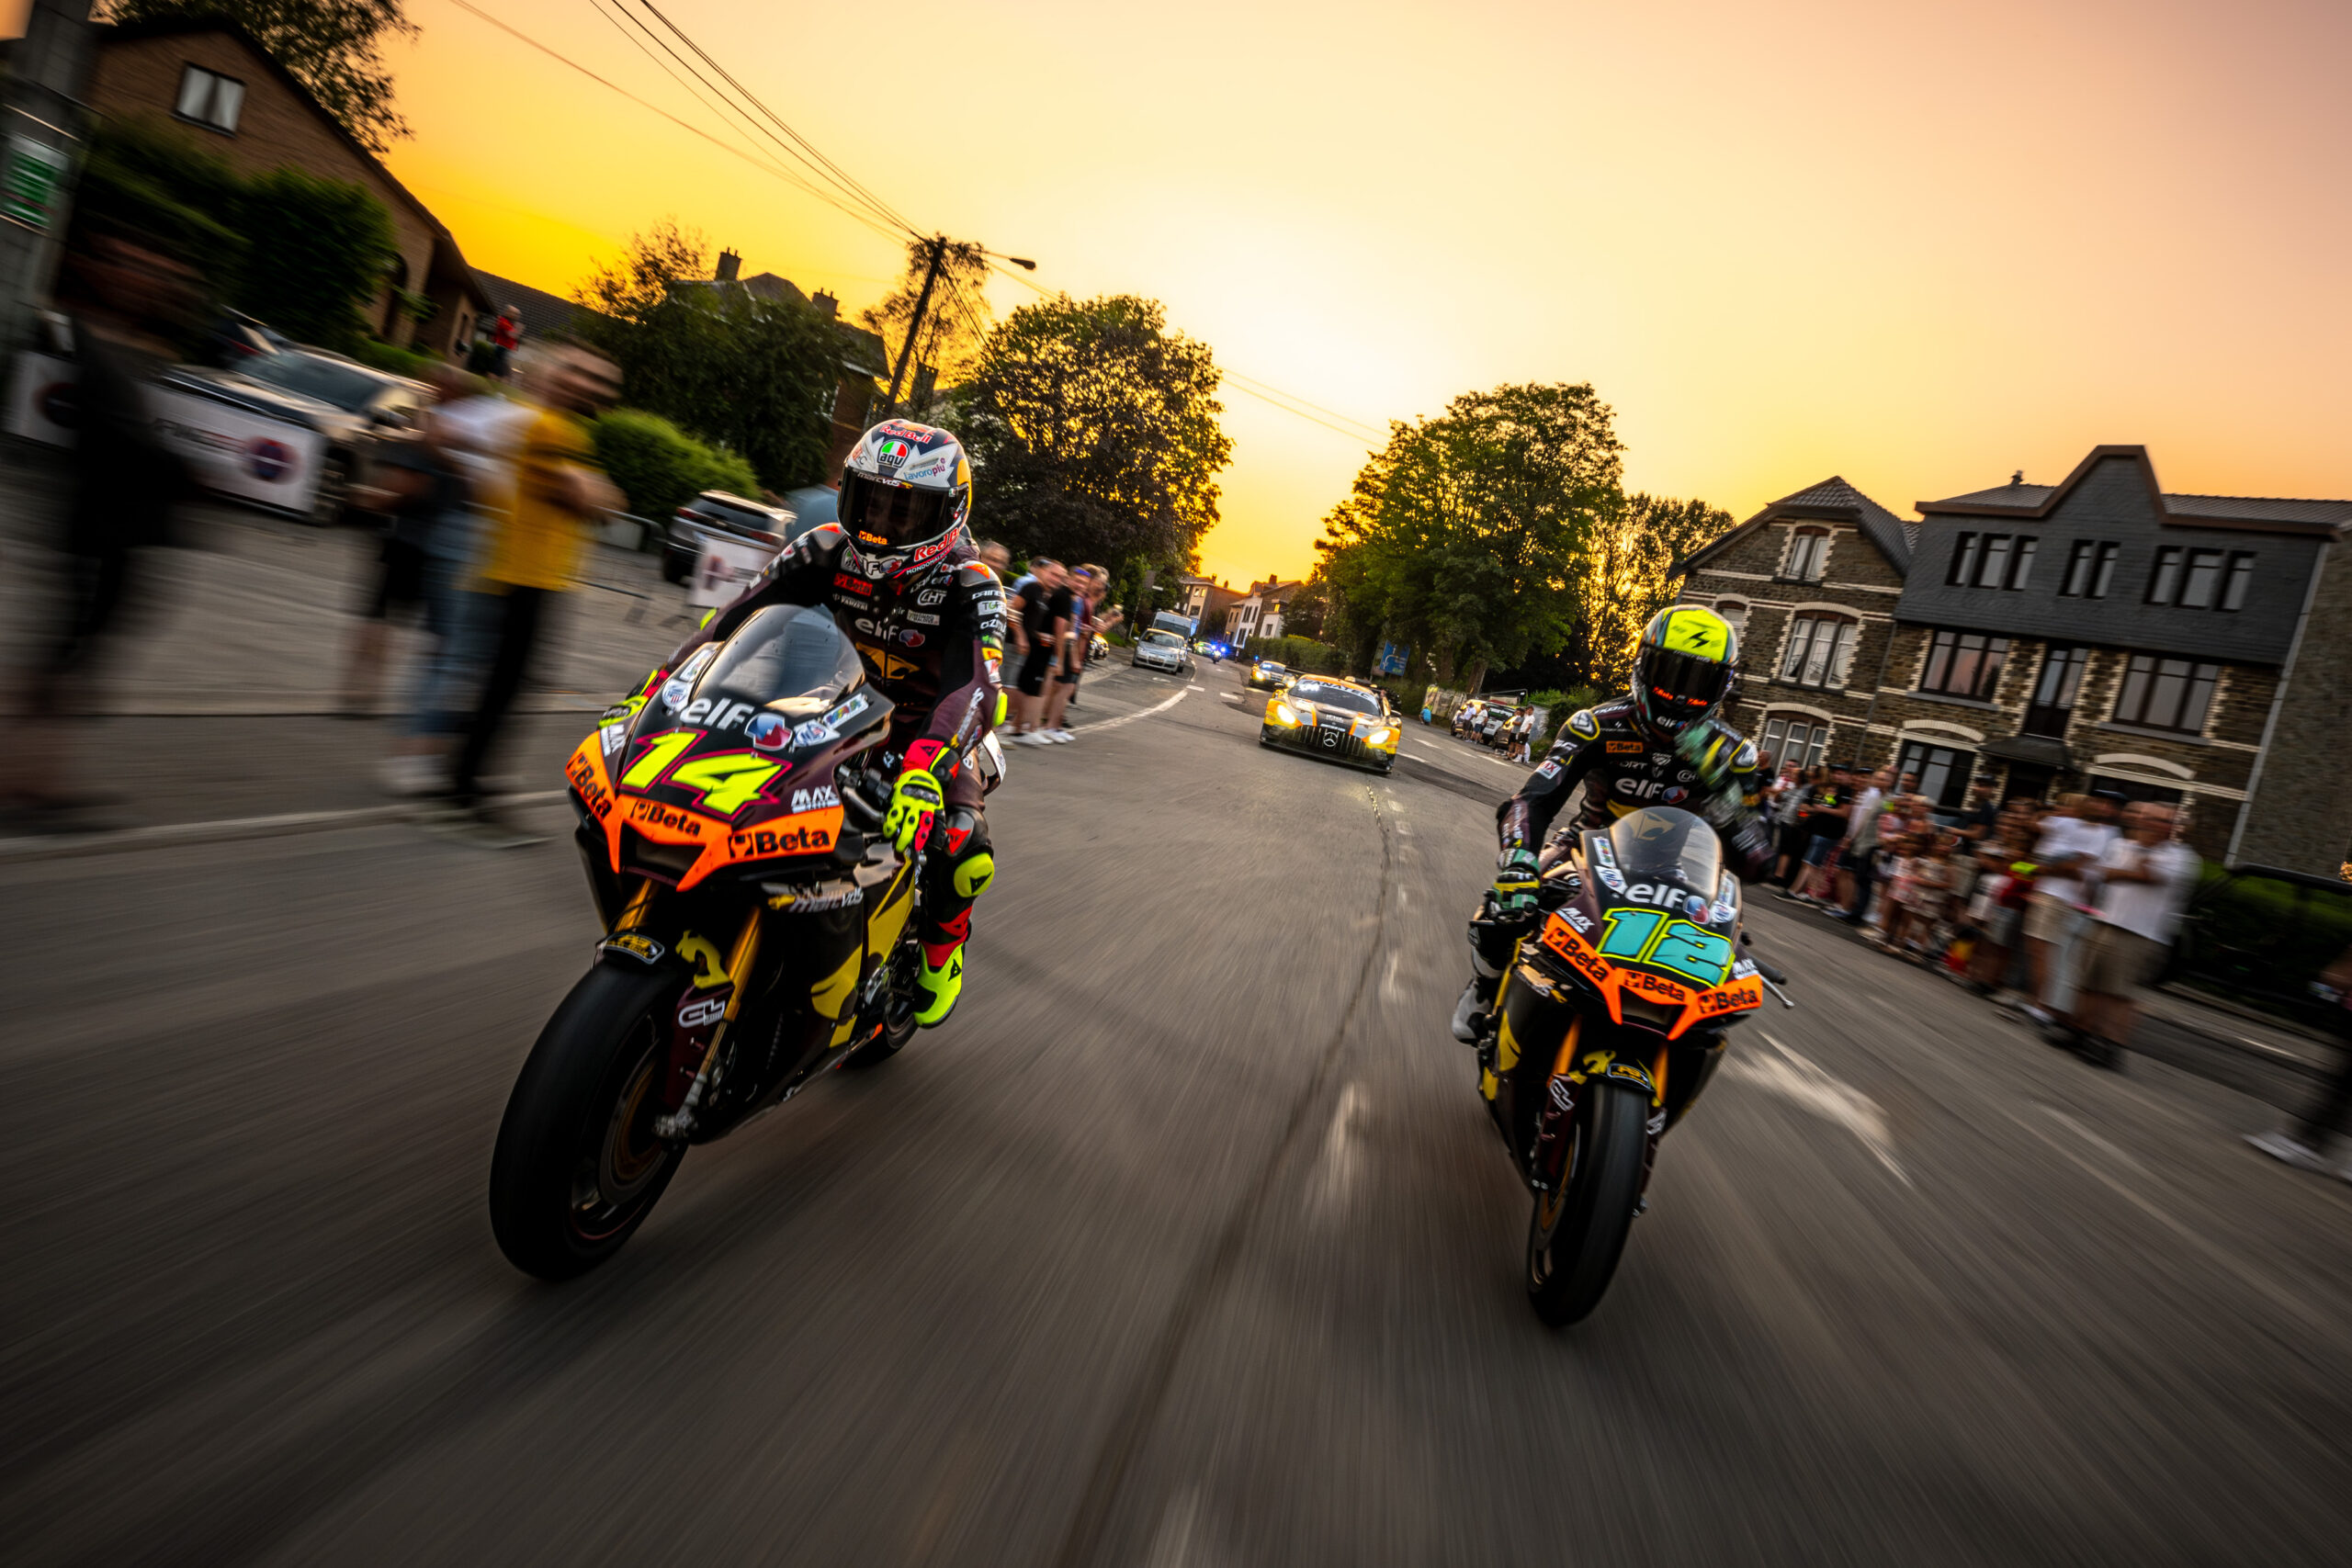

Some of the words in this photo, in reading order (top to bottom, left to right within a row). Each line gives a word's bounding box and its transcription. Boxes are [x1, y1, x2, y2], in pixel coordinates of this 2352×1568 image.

[879, 425, 904, 437] Red
[904, 431, 933, 445] Bull
[879, 453, 904, 466] agv
[865, 533, 888, 545] Beta
[913, 533, 949, 562] Red
[680, 697, 755, 731] elf
[1657, 716, 1678, 728] elf
[1617, 742, 1641, 751] Beta
[616, 727, 792, 821] 14
[574, 764, 613, 820] Beta
[790, 784, 841, 808] MAX
[1614, 777, 1665, 800] elf
[647, 804, 702, 838] Beta
[754, 826, 831, 855] Beta
[1624, 883, 1688, 909] elf
[1561, 937, 1610, 983] Beta
[1595, 907, 1736, 990] 12
[1642, 975, 1686, 1002] Beta
[1715, 987, 1759, 1010] Beta
